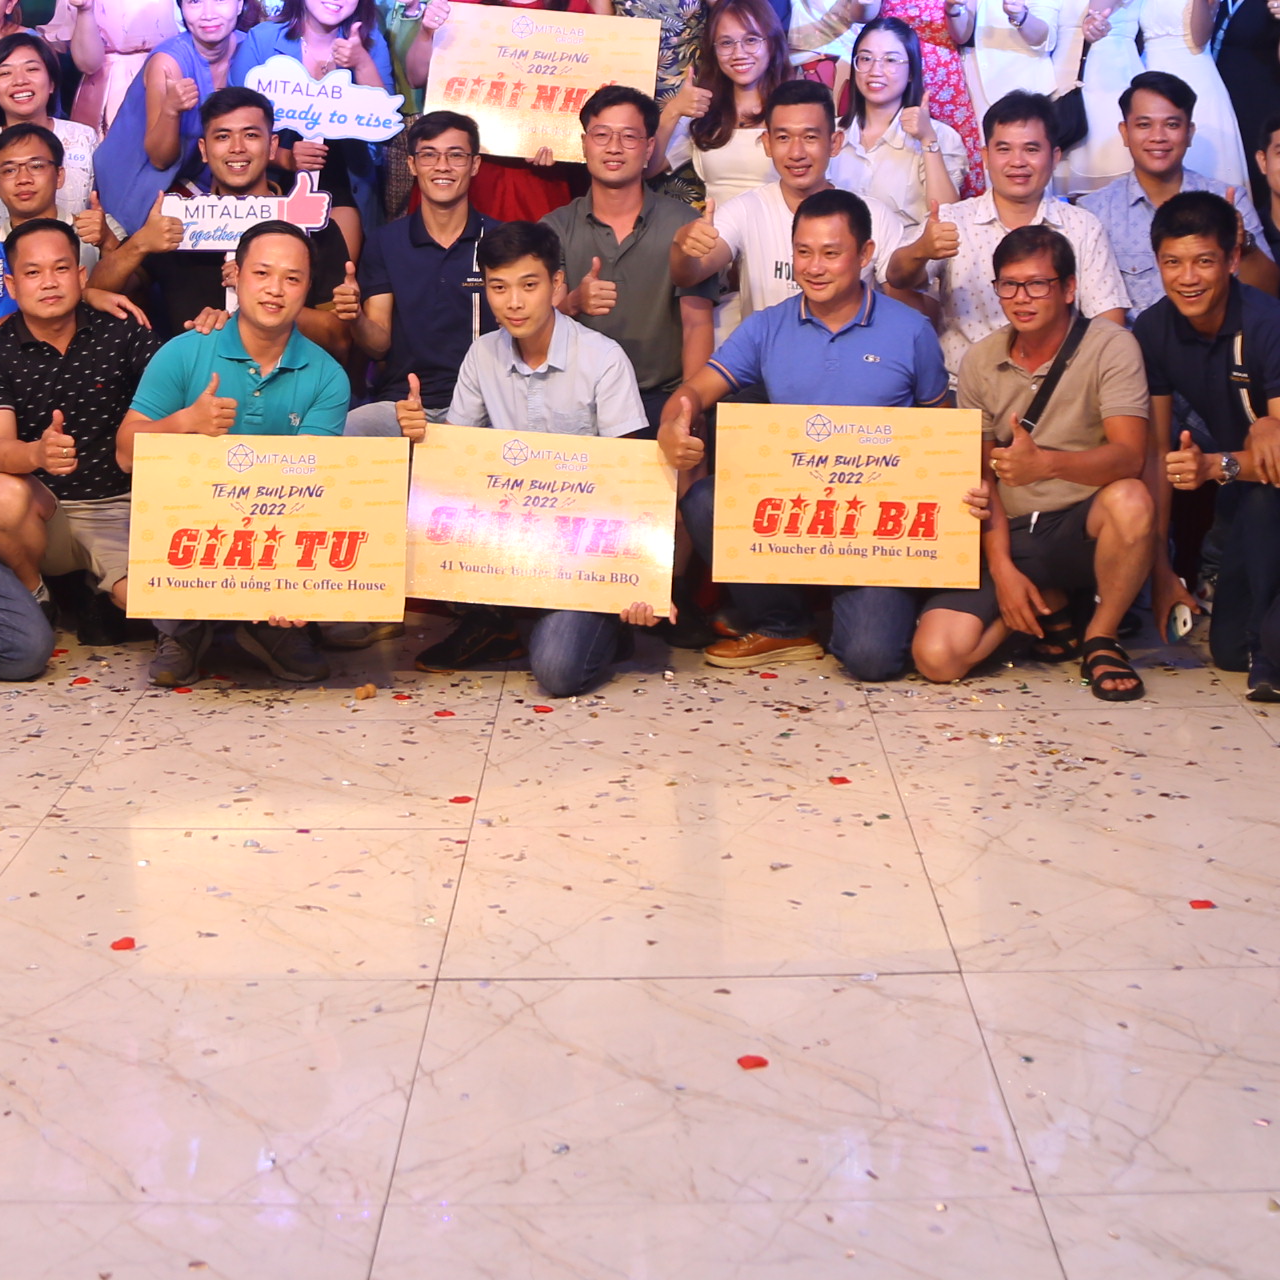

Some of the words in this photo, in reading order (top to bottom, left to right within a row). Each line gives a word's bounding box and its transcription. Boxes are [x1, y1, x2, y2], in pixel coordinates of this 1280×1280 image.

[535, 24, 585, 36] MITALAB
[555, 37, 585, 45] GROUP
[497, 45, 529, 59] TEAM
[532, 50, 590, 64] BUILDING
[526, 64, 558, 75] 2022
[256, 78, 343, 99] MITALAB
[328, 108, 348, 124] to
[354, 111, 394, 129] rise
[68, 153, 86, 161] 169
[184, 204, 272, 220] MITALAB
[833, 424, 892, 435] MITALAB
[858, 437, 892, 445] GROUP
[255, 453, 317, 465] MITALAB
[530, 449, 589, 463] MITALAB
[791, 452, 829, 468] TEAM
[834, 454, 901, 468] BUILDING
[281, 467, 317, 475] GROUP
[554, 463, 589, 472] GROUP
[487, 474, 524, 490] TEAM
[529, 478, 596, 495] BUILDING
[828, 472, 864, 484] 2022
[211, 483, 250, 499] TEAM
[255, 485, 325, 499] BUILDING
[249, 503, 287, 516] 2022
[523, 496, 559, 509] 2022
[872, 501, 941, 541] BA
[295, 530, 369, 571] TƯ
[750, 543, 763, 553] 41
[768, 543, 816, 555] Voucher
[820, 541, 835, 556] đồ
[838, 541, 868, 558] uống
[872, 545, 903, 557] Phúc
[906, 547, 938, 560] Long
[440, 560, 454, 571] 41
[459, 562, 507, 575] Voucher
[576, 570, 606, 582] Taka
[610, 573, 640, 586] BBQ
[148, 577, 162, 588] 41
[166, 577, 217, 589] Voucher
[221, 575, 236, 589] đồ
[240, 575, 271, 592] uống
[275, 579, 299, 590] The
[303, 579, 343, 591] Coffee
[347, 579, 387, 591] House
